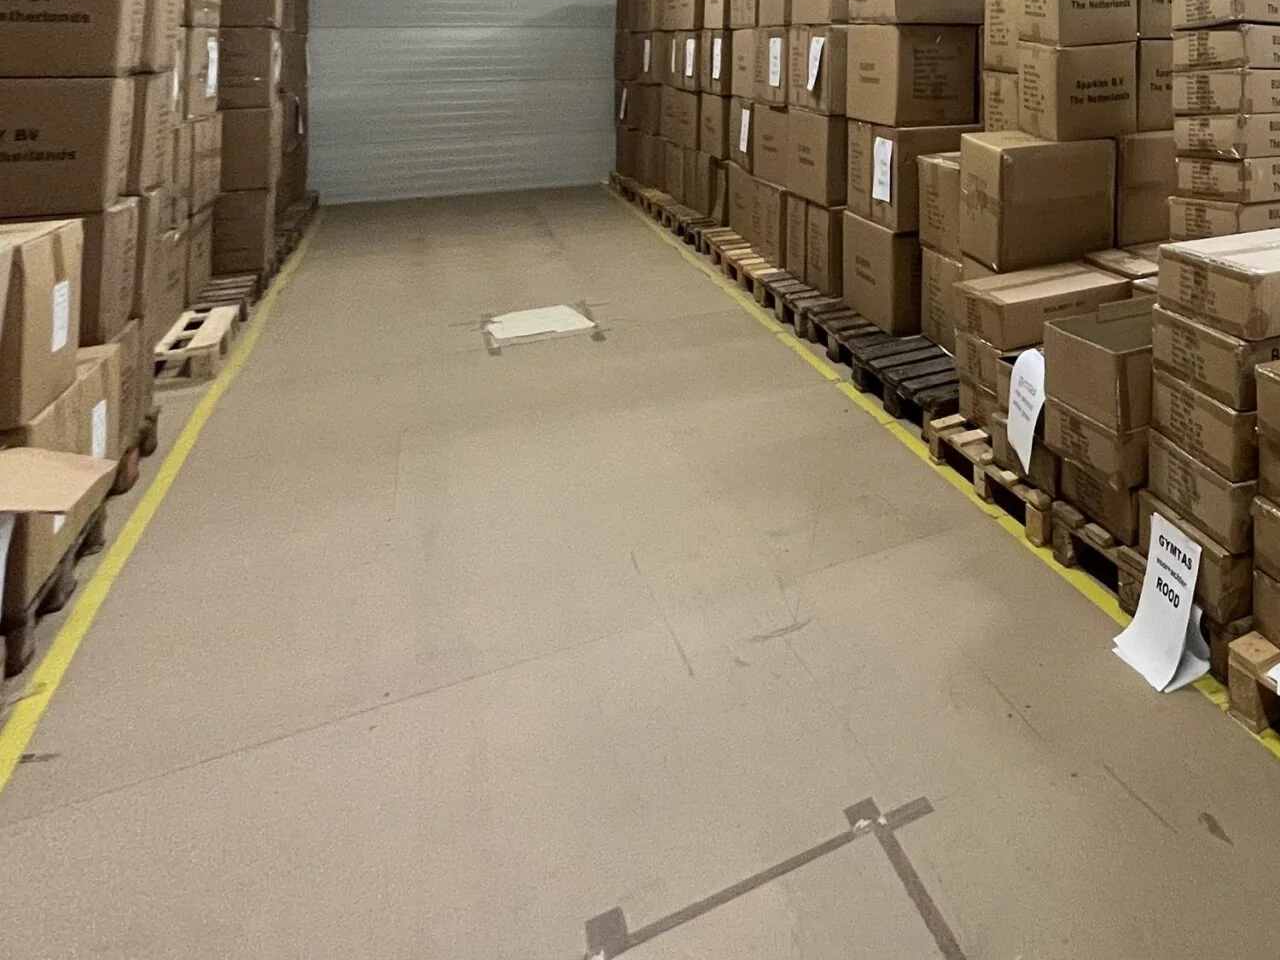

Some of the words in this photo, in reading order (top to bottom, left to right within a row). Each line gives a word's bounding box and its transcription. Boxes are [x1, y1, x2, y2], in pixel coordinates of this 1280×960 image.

[1071, 0, 1085, 10] The
[1159, 534, 1193, 570] GYMTAS
[1156, 577, 1180, 608] ROOD
